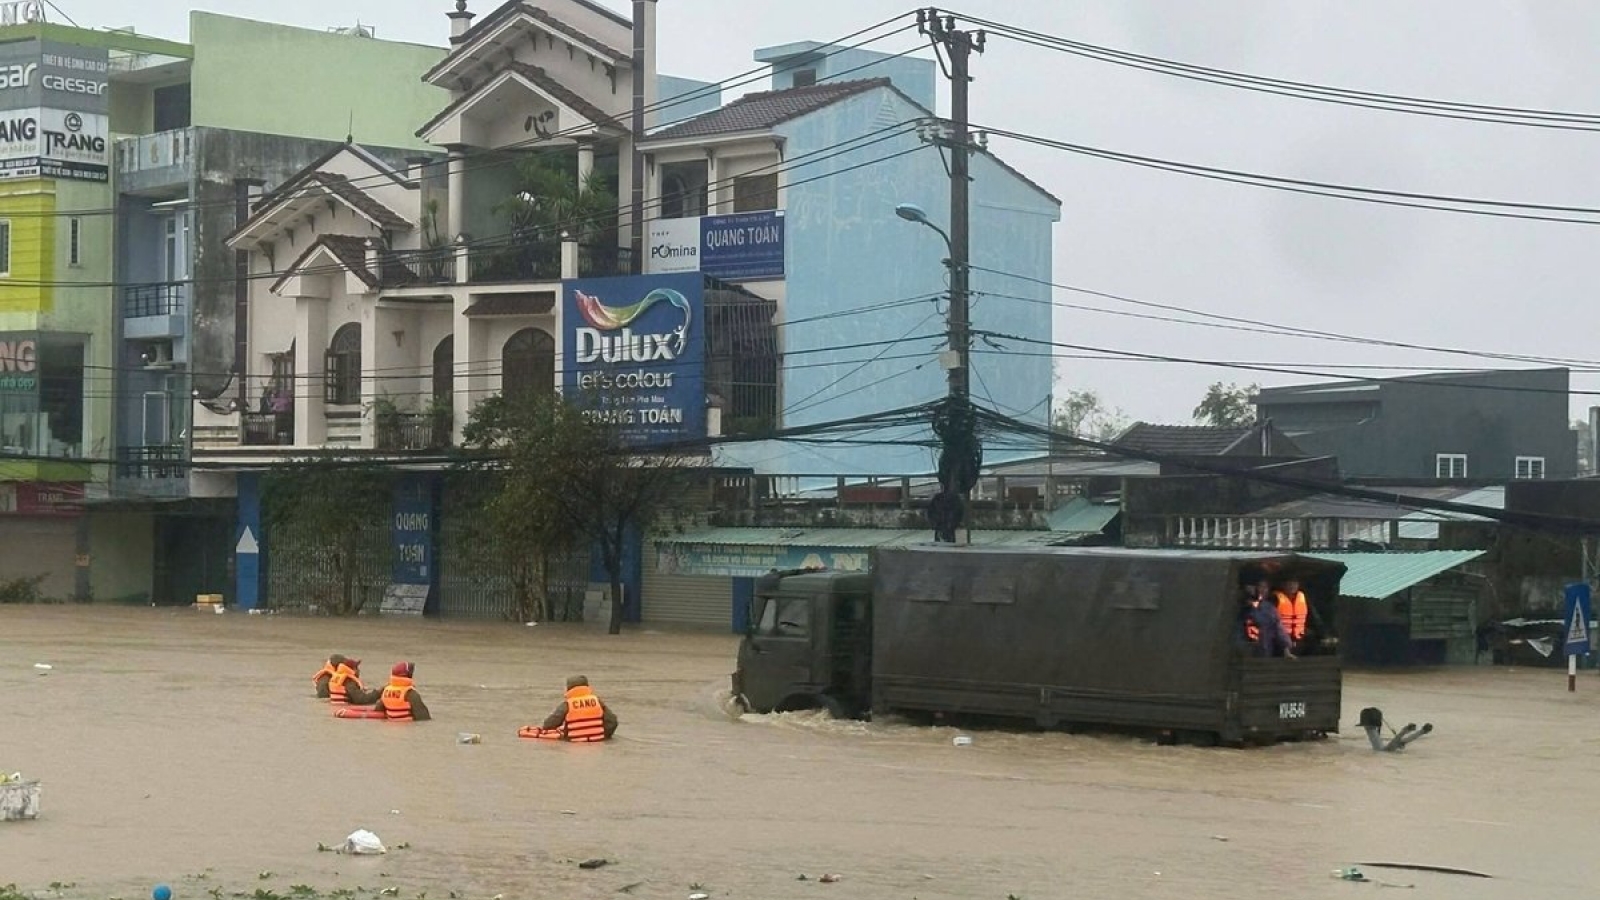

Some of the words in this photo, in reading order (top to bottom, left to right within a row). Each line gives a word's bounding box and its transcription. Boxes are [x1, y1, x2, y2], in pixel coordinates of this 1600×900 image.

[42, 74, 108, 95] caesar
[42, 129, 105, 155] TRANG
[706, 228, 745, 250] QUANG
[747, 222, 779, 244] TOÁN
[575, 327, 676, 362] Dulux
[615, 369, 676, 389] colour
[640, 405, 682, 423] TOÁN
